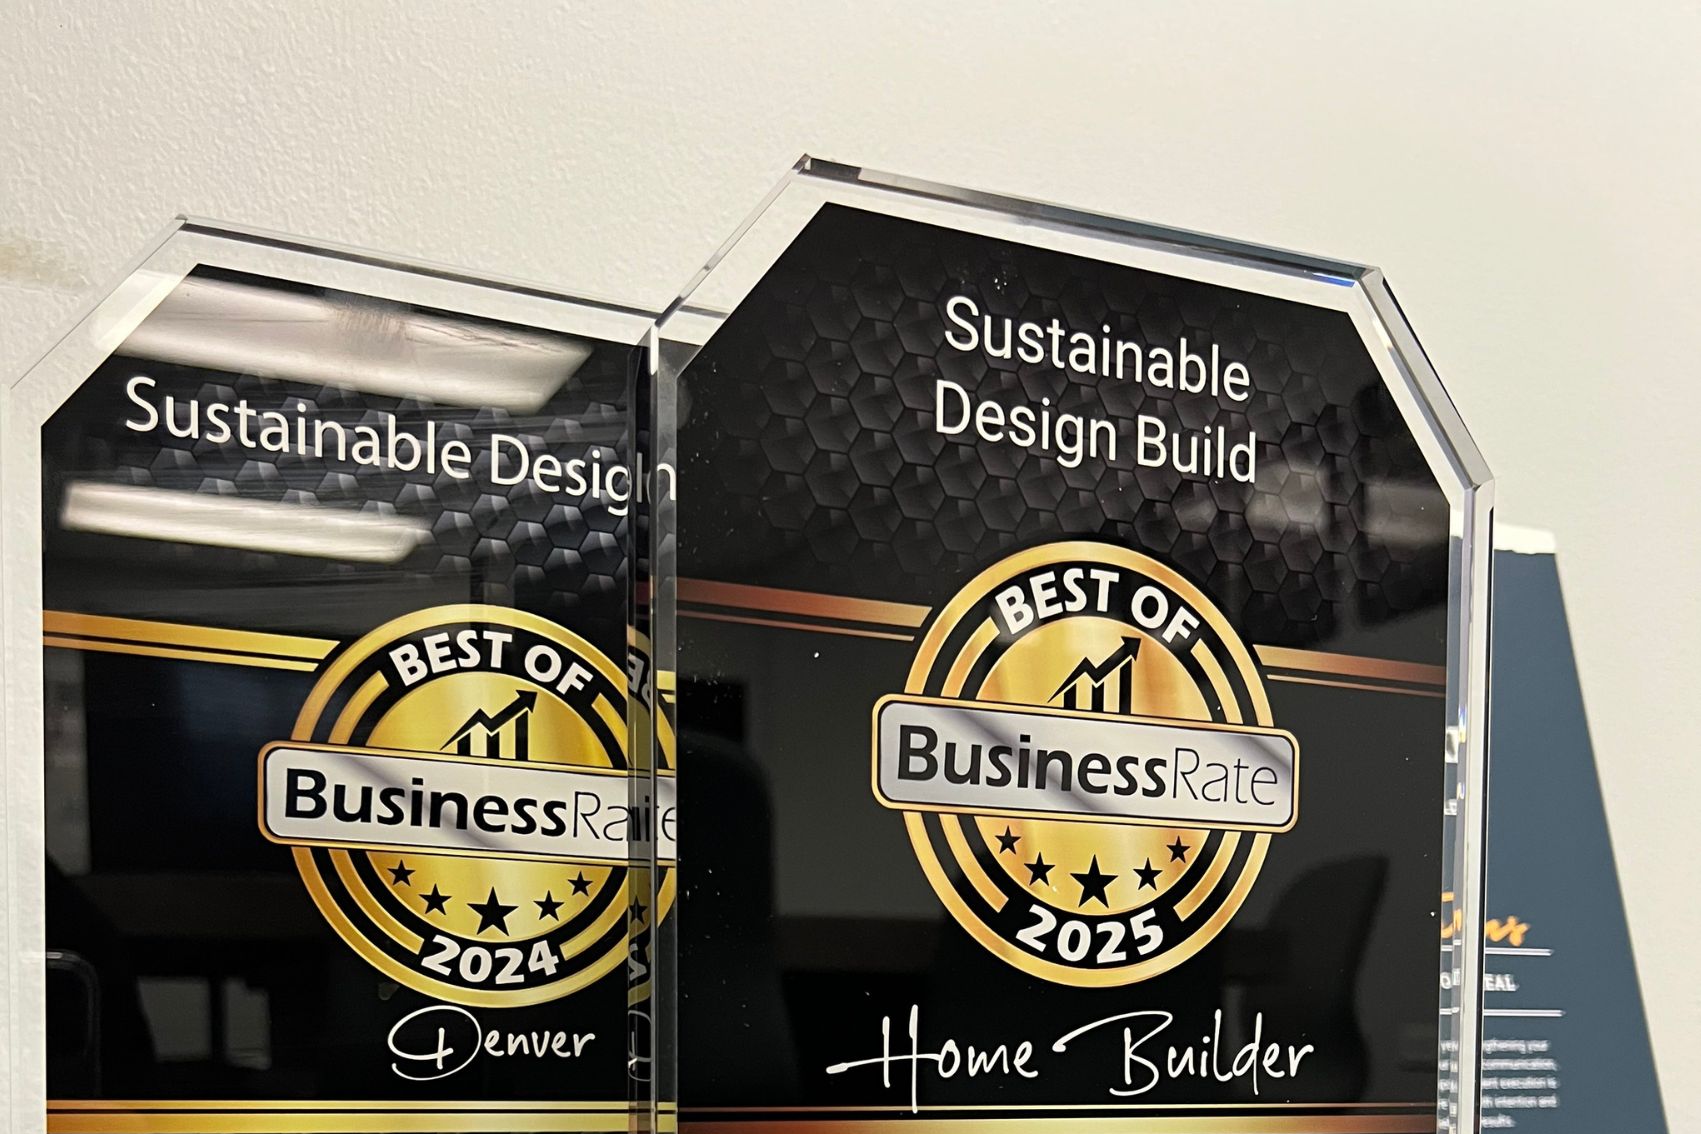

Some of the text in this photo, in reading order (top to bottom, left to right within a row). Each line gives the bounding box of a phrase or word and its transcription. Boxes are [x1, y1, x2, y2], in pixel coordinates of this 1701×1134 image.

[945, 296, 1250, 401] Sustainable
[125, 376, 472, 480] Sustainable
[935, 380, 1257, 483] Design Build
[996, 567, 1200, 646] BEST OF
[389, 630, 513, 687] BEST
[523, 645, 594, 696] OF
[897, 724, 1278, 806] BusinessRate
[421, 934, 559, 984] 2024
[1015, 905, 1164, 964] 2025
[387, 1004, 596, 1081] Denver
[826, 1004, 1315, 1114] Home Builder
